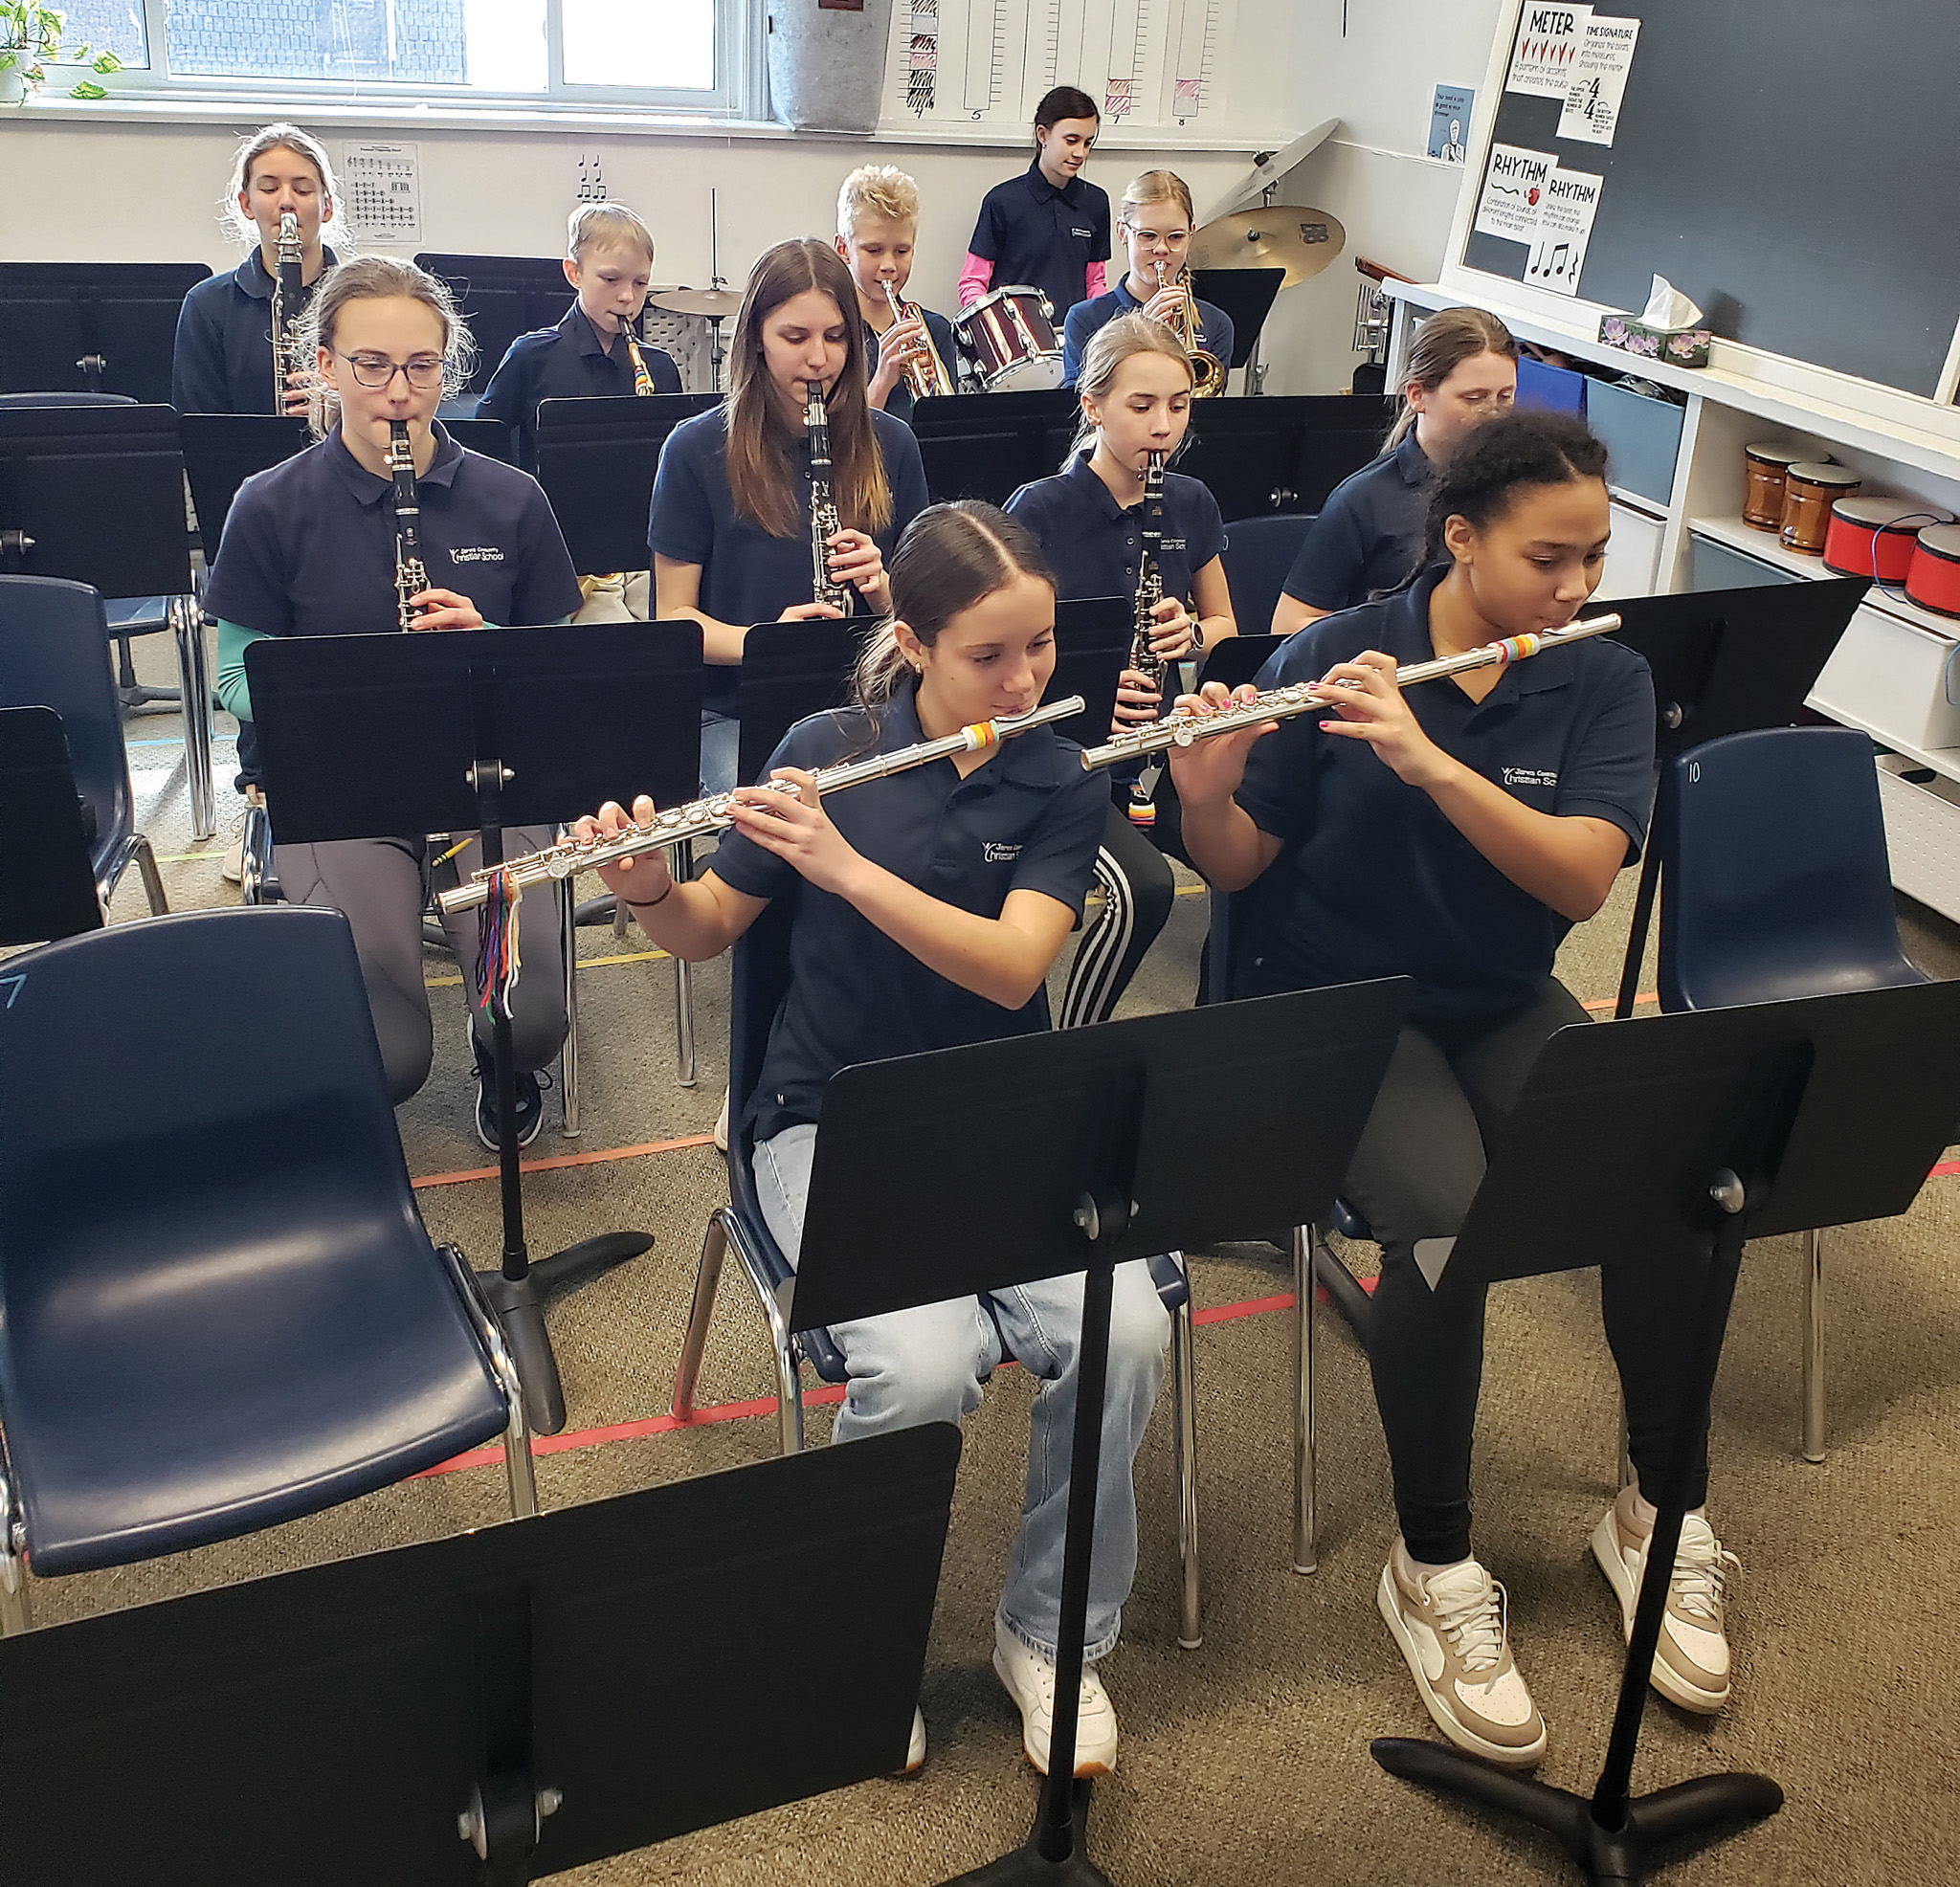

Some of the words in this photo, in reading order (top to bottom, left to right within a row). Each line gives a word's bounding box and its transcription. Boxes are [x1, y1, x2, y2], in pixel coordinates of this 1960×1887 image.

[1529, 10, 1574, 36] METER
[1599, 26, 1634, 40] SIGNATURE
[1589, 77, 1600, 99] 4
[913, 107, 924, 120] 4
[970, 110, 982, 121] 5
[1583, 99, 1595, 120] 4
[1493, 153, 1548, 184] RHYTHM
[1548, 179, 1596, 204] RHYTHM
[481, 552, 504, 561] School
[1688, 762, 1701, 783] 10
